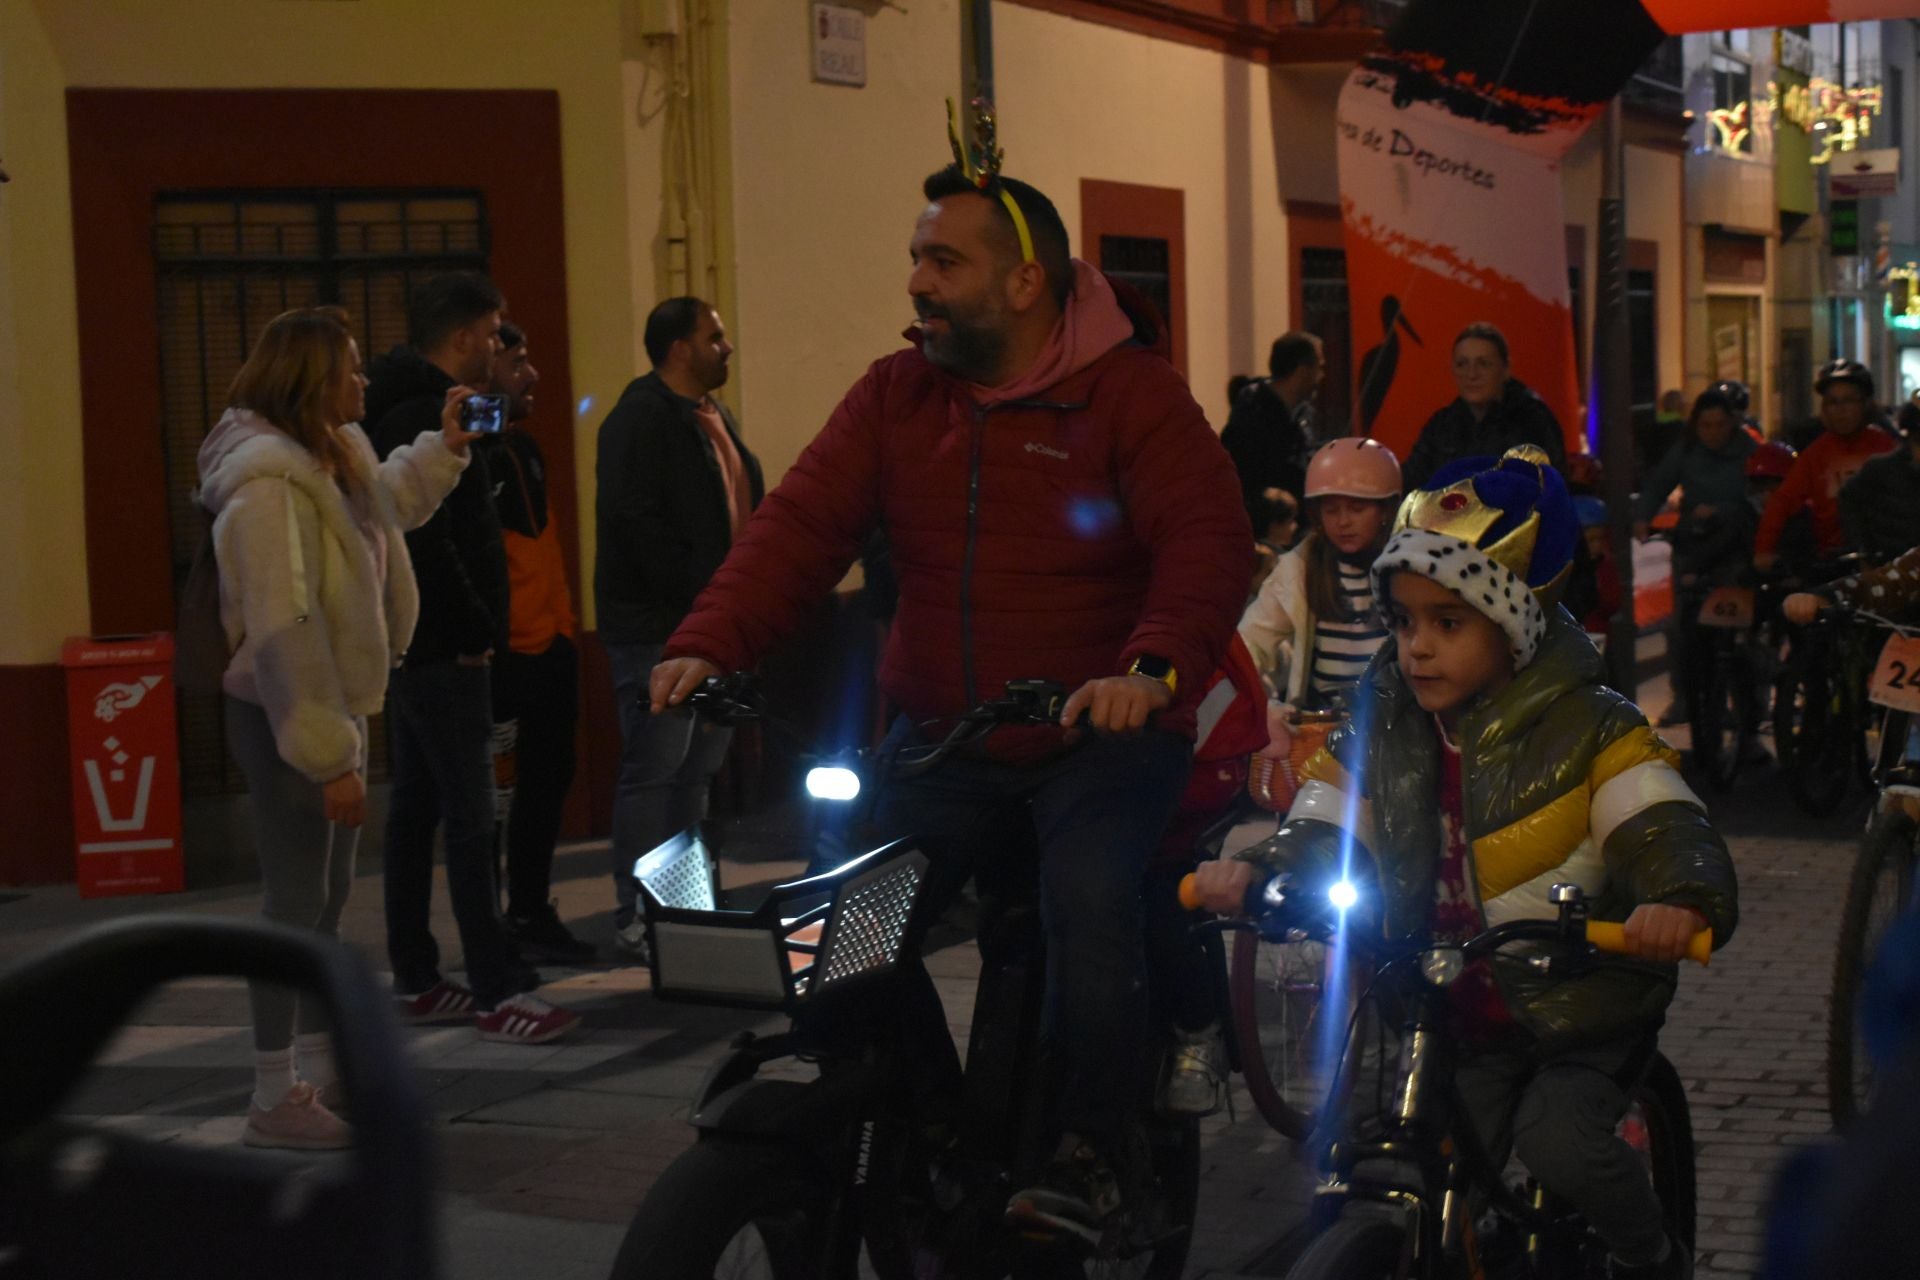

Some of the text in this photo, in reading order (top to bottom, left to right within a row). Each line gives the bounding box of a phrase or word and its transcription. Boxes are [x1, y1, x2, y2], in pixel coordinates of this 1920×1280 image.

[820, 49, 859, 77] REAL
[1361, 127, 1383, 152] de
[1389, 128, 1495, 189] Deportes
[854, 1120, 875, 1185] YAMAHA
